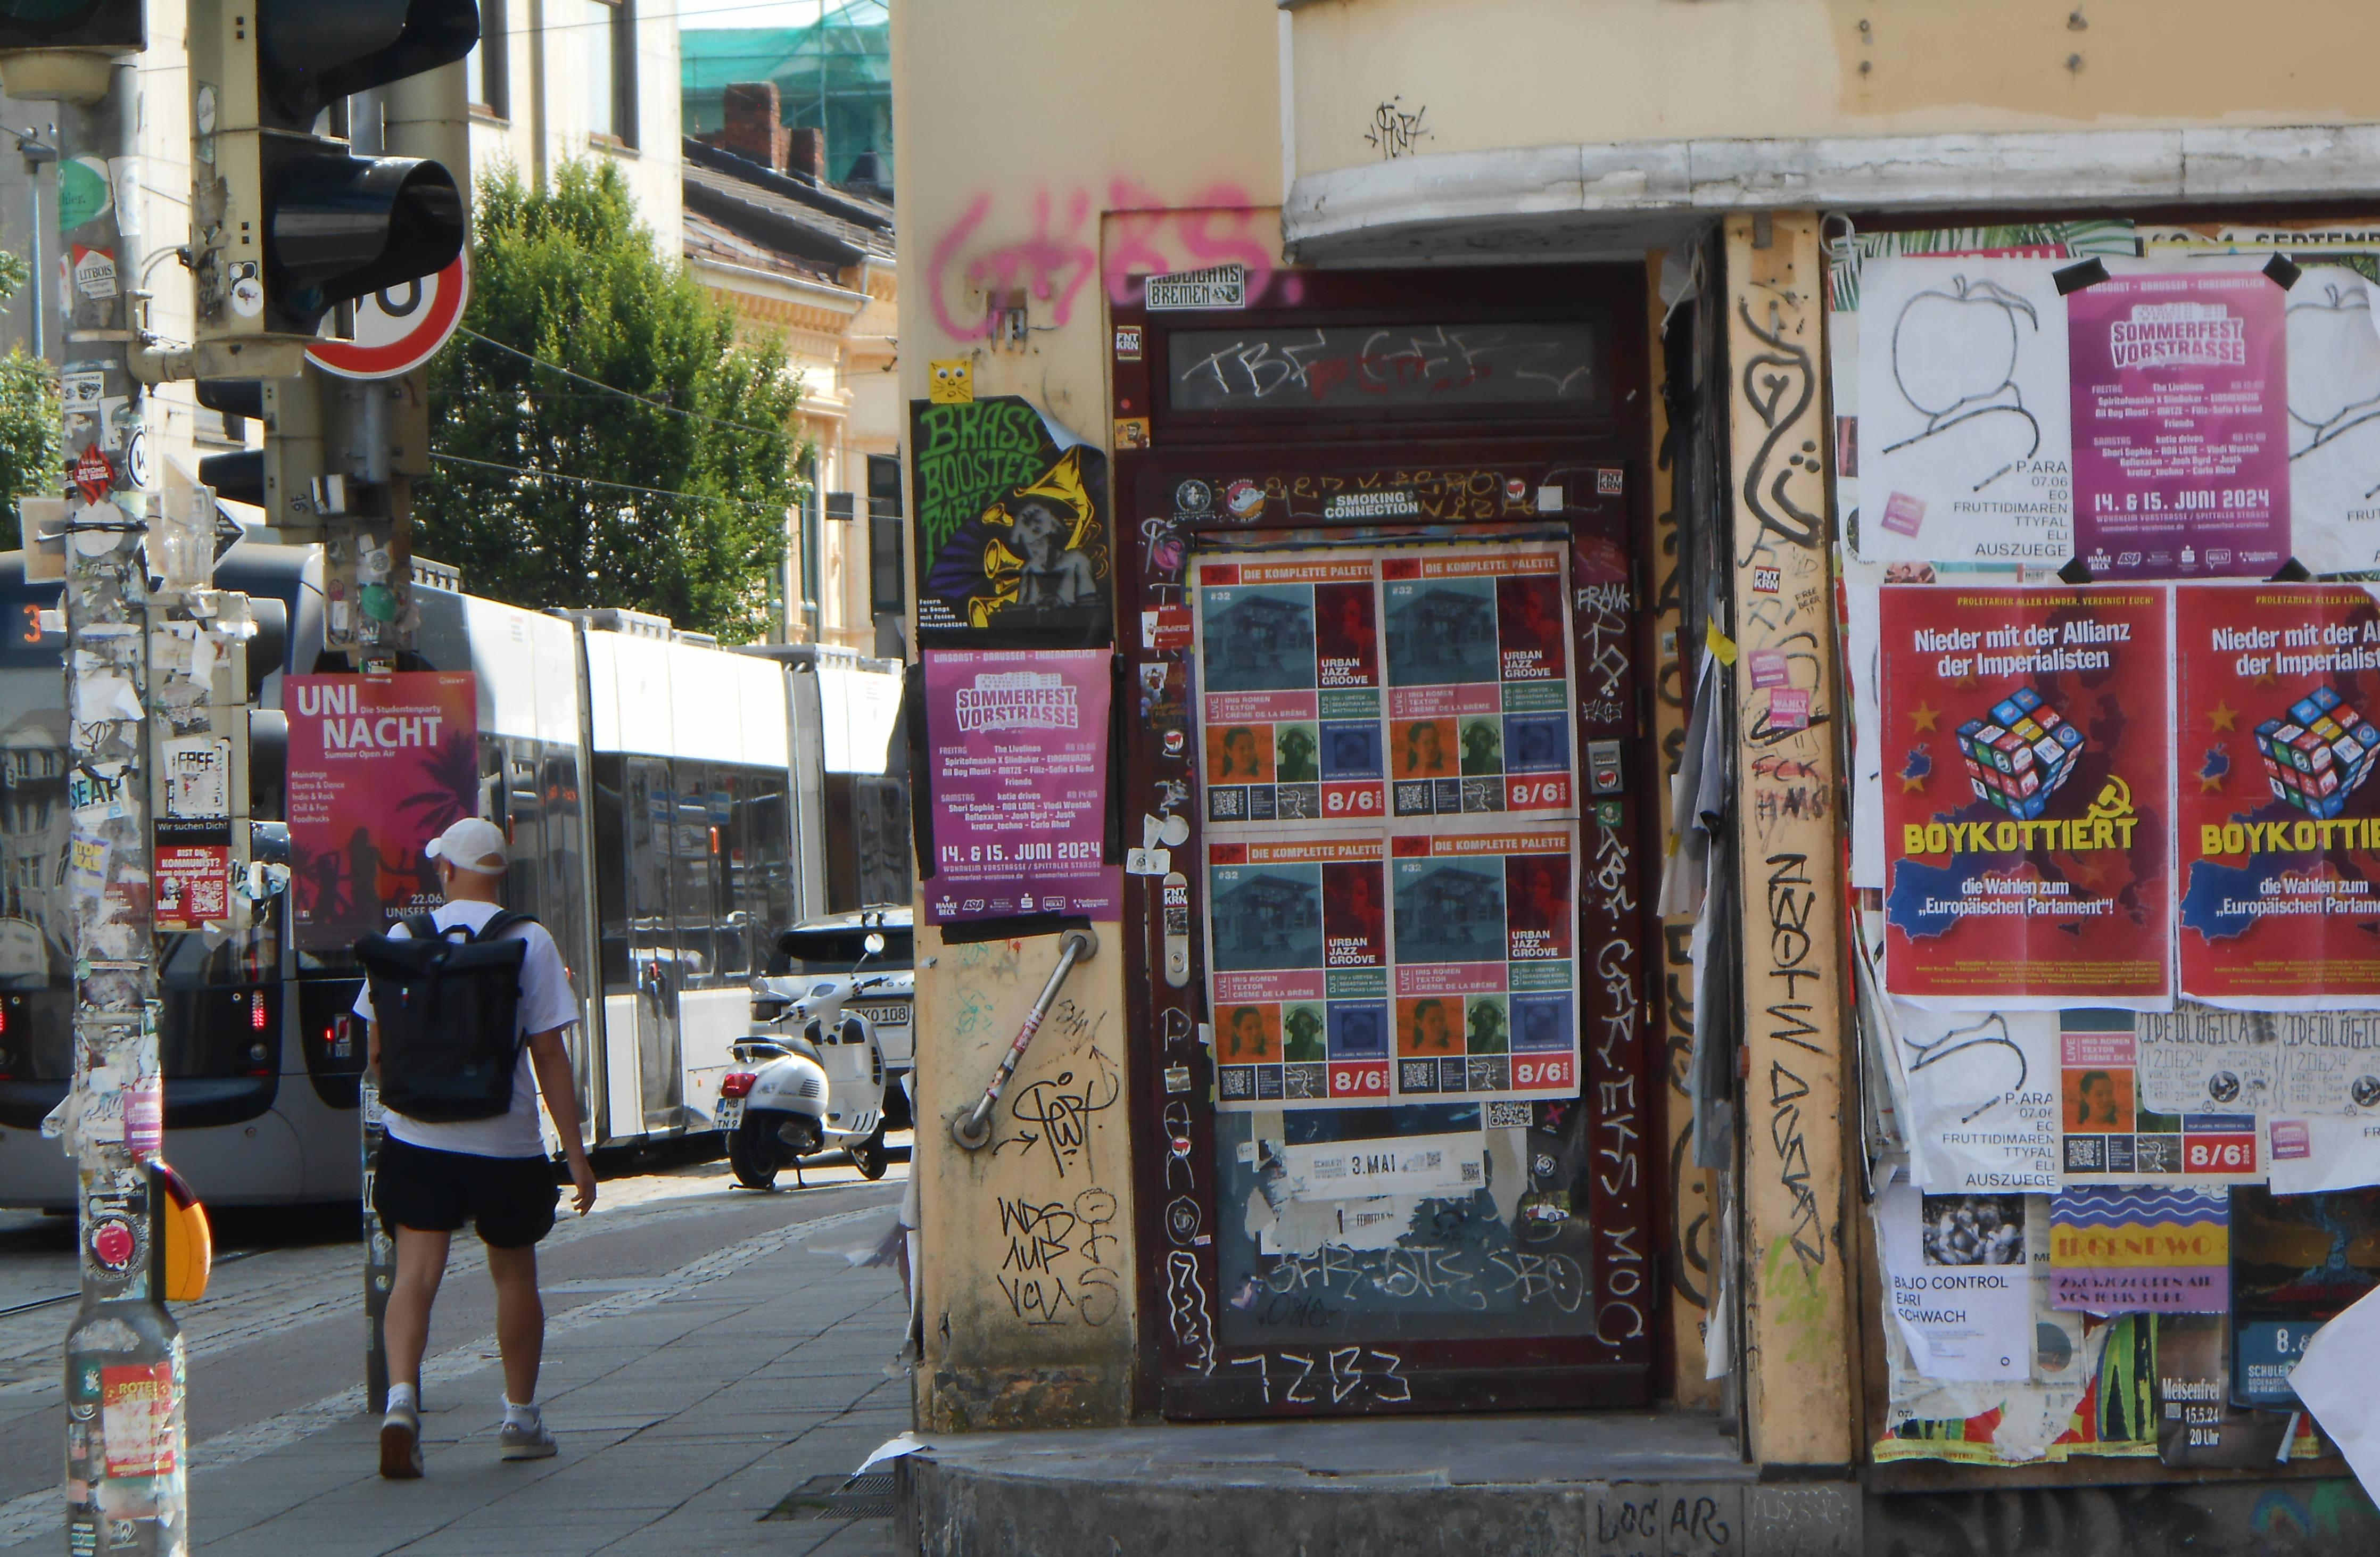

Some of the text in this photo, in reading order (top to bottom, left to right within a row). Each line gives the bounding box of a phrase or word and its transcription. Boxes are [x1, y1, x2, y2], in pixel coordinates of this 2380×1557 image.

[1152, 285, 1209, 304] BREMEN
[1117, 333, 1138, 342] FNT
[2114, 321, 2243, 342] SOMMERFEST
[1117, 341, 1139, 350] KRN
[2114, 341, 2243, 366] VORSTRASSE
[919, 400, 1042, 461] BRASS
[2016, 461, 2068, 473] P.ARA
[920, 449, 1045, 510] BOOSTER
[1599, 481, 1622, 490] KRN
[2031, 476, 2068, 487] 07.06
[1336, 492, 1405, 507] SMOKING
[2049, 490, 2068, 500] EO
[2095, 493, 2120, 511] 14.
[2144, 492, 2168, 510] 15.
[2175, 490, 2216, 509] JUNI
[2222, 489, 2269, 508] 2024
[1325, 502, 1419, 519] CONNECTION
[1954, 502, 2068, 514] FRUTTIDIMAREN
[2015, 516, 2067, 527] TTYFAL
[921, 484, 1011, 577] PARTY
[1975, 544, 2068, 557] AUSZUEGE
[1244, 567, 1327, 579] DIE KOMPLETTE
[1426, 558, 1556, 574] DIE KOMPLETTE PALETTE
[1755, 569, 1779, 580] FNT
[1755, 577, 1779, 590] KRN
[1958, 597, 2014, 607] PROLETARIER
[2017, 597, 2043, 606] ALLER
[2082, 596, 2127, 606] VEREINIGT
[24, 604, 41, 643] 3
[1914, 620, 2131, 652] Nieder mit der Allianz
[2212, 623, 2358, 651] Nieder mit der
[1504, 650, 1542, 660] URBAN
[1321, 658, 1360, 668] URBAN
[1505, 659, 1533, 668] JAZZ
[1938, 648, 2110, 678] der Imperialisten
[2236, 654, 2271, 676] der
[1321, 667, 1350, 676] JAZZ
[1505, 667, 1550, 677] GROOVE
[1322, 675, 1368, 685] GROOVE
[298, 685, 357, 716] UNI
[958, 688, 1077, 708] SOMMERFEST
[361, 705, 442, 715] Die Studentenparty
[959, 706, 1076, 730] VORSTRASSE
[324, 717, 443, 748] NACHT
[325, 751, 357, 759] Summer
[359, 750, 381, 759] Open
[1328, 790, 1374, 811] 8/6
[1513, 783, 1559, 803] 8/6
[206, 822, 228, 830] Dich!
[1904, 817, 2139, 855] BOYKOTTIERT
[942, 845, 964, 862] 14.
[987, 844, 1009, 860] 15.
[1014, 843, 1052, 860] JUNI
[1057, 841, 1101, 859] 2024
[1252, 844, 1383, 859] DIE KOMPLETTE PALETTE
[1435, 837, 1566, 851] DIE KOMPLETTE PALETTE
[1164, 888, 1186, 897] FNT
[1962, 877, 2069, 896] die Wahlen zum
[2260, 877, 2369, 895] die Wahlen zum
[411, 893, 446, 904] 22.06.
[1164, 896, 1187, 905] KRN
[1919, 897, 2024, 917] „Europäischen
[1329, 937, 1367, 947] URBAN
[1512, 930, 1550, 940] URBAN
[1329, 946, 1357, 955] JAZZ
[1512, 939, 1540, 948] JAZZ
[1513, 947, 1558, 957] GROOVE
[1329, 955, 1376, 965] GROOVE
[882, 1007, 906, 1021] 108
[1518, 1063, 1561, 1083] 8/6
[1335, 1071, 1381, 1091] 8/6
[1943, 1134, 2054, 1144] FRUTTIDIMAREN
[2004, 1147, 2054, 1157] TTYFAL
[2191, 1144, 2241, 1165] 8/6
[1351, 1154, 1396, 1175] 3.MAI
[1966, 1173, 2055, 1187] AUSZUEGE
[2059, 1236, 2211, 1257] IRGENDWO
[1894, 1275, 2009, 1290] BAJO CONTROL
[1898, 1308, 1966, 1323] SCHWACH
[2248, 1364, 2284, 1379] SCHULE
[2162, 1377, 2220, 1401] Meisenfrei
[2185, 1407, 2219, 1423] 15.5.24
[2189, 1428, 2220, 1446] 20 Uhr
